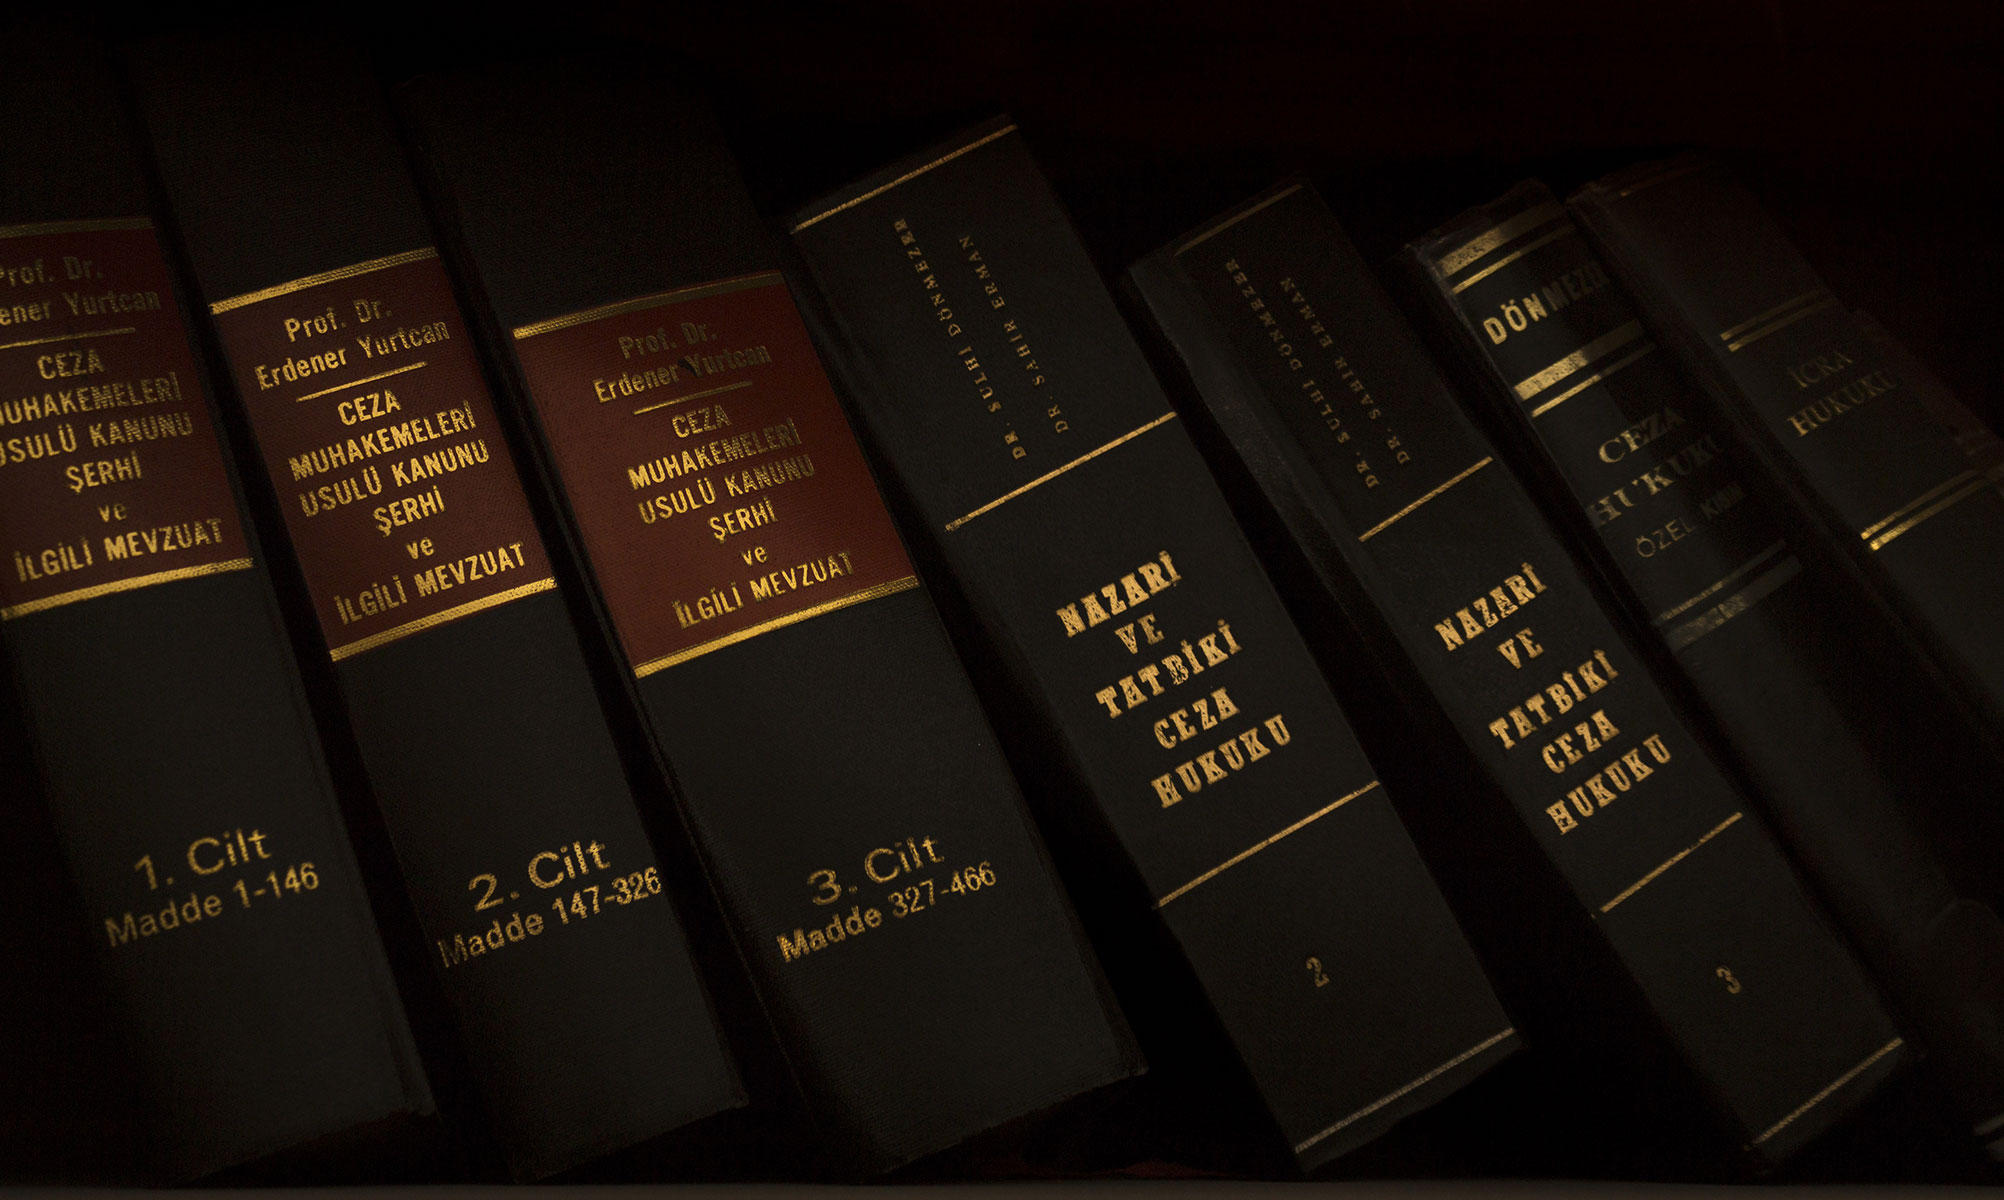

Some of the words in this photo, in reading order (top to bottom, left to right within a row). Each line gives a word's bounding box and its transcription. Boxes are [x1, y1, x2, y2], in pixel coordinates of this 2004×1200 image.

[63, 255, 104, 280] Dr.
[958, 235, 1006, 310] ERMAN
[62, 287, 161, 317] Yurtcan
[283, 306, 348, 343] Prof.
[354, 298, 393, 324] Dr.
[1280, 276, 1333, 349] ERMAN
[37, 348, 104, 380] CEZA
[254, 348, 347, 391] Erdener
[357, 319, 451, 361] Yurtcan
[617, 327, 677, 360] Prof.
[680, 322, 719, 347] Dr.
[592, 362, 681, 404] Erdener
[684, 344, 772, 379] Yurtcan
[89, 411, 193, 448] KANUNU
[337, 389, 401, 427] CEZA
[670, 404, 733, 439] CEZA
[1048, 395, 1069, 434] DR.
[1599, 407, 1687, 463] CEZA
[288, 400, 478, 482] MUHAKEMELERİ
[627, 417, 802, 491] MUHAKEMELERİ
[1003, 421, 1027, 461] DR.
[1355, 451, 1380, 488] DR.
[1387, 427, 1411, 464] DR.
[65, 450, 142, 494] ŞERHİ
[299, 464, 382, 518] USULÜ
[391, 439, 491, 488] KANUNU
[637, 478, 717, 525] USULÜ
[725, 454, 816, 498] KANUNU
[98, 502, 127, 524] ve
[372, 485, 446, 538] ŞERHİ
[708, 495, 778, 545] ŞERHİ
[1635, 517, 1695, 558] ÖZEL
[14, 536, 94, 584] İLGİLİ
[104, 518, 224, 563] MEVZUAT
[406, 536, 436, 560] ve
[740, 546, 768, 566] ve
[333, 574, 408, 625] İLGİLİ
[413, 541, 527, 598] MEVZUAT
[671, 582, 744, 631] İLGİLİ
[749, 551, 855, 602] MEVZUAT
[1056, 550, 1182, 638] NAZARİ
[1434, 562, 1548, 652] NAZARİ
[1114, 611, 1165, 655] VE
[1497, 627, 1544, 670] VE
[1095, 618, 1243, 719] TATBİKİ
[1153, 686, 1240, 750] CEZA
[1488, 649, 1619, 750] TATBİKİ
[1151, 713, 1292, 809] HUKUKU
[1541, 709, 1620, 774] CEZA
[1545, 733, 1672, 836] HUKUKU
[134, 854, 175, 892] 1.
[186, 827, 273, 876] Cilt
[468, 872, 520, 913] 2.
[527, 839, 612, 890] Cilt
[807, 868, 859, 905] 3.
[864, 834, 945, 884] Cilt
[103, 891, 223, 948] Madde
[232, 861, 320, 910] 1-146
[436, 910, 545, 969] Madde
[552, 865, 663, 926] 147-326
[776, 905, 883, 963] Madde
[888, 860, 998, 919] 327-466
[1305, 955, 1331, 988] 2
[1715, 964, 1742, 994] 3
